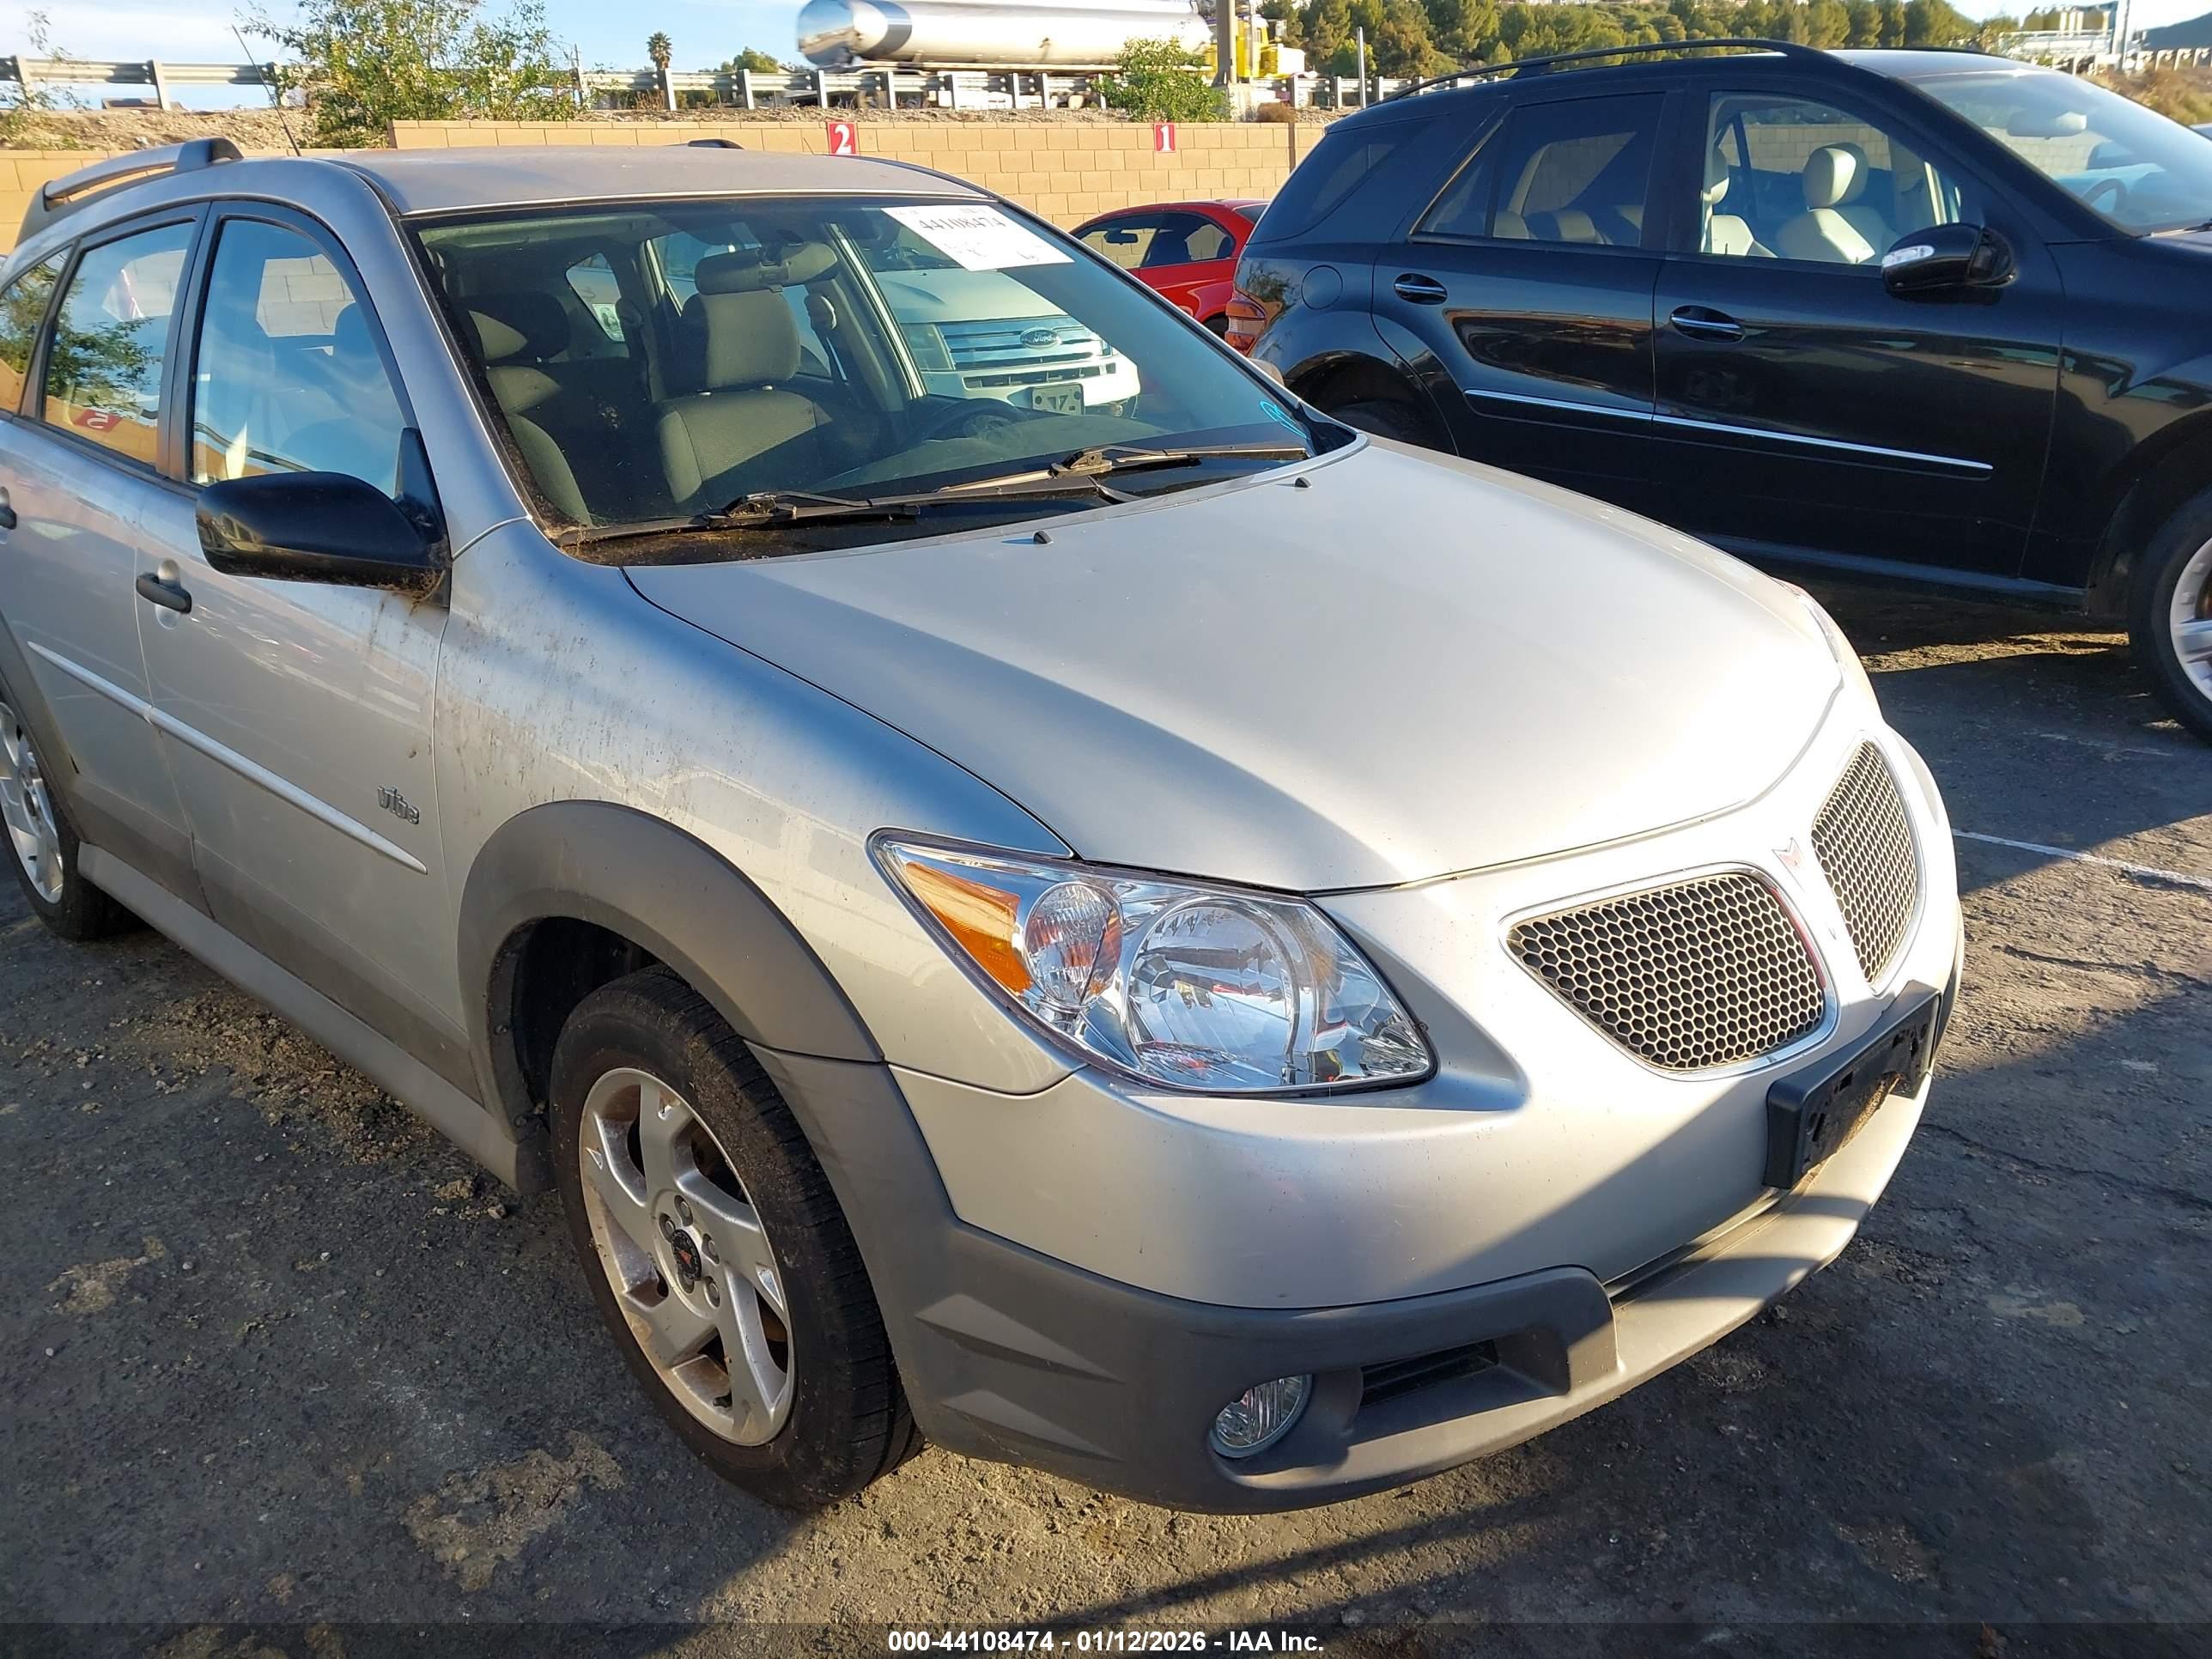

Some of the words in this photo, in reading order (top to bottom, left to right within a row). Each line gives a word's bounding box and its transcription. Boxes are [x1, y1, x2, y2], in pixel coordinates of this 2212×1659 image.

[834, 124, 852, 154] 2
[1160, 125, 1172, 151] 1
[918, 217, 1007, 231] 44108474
